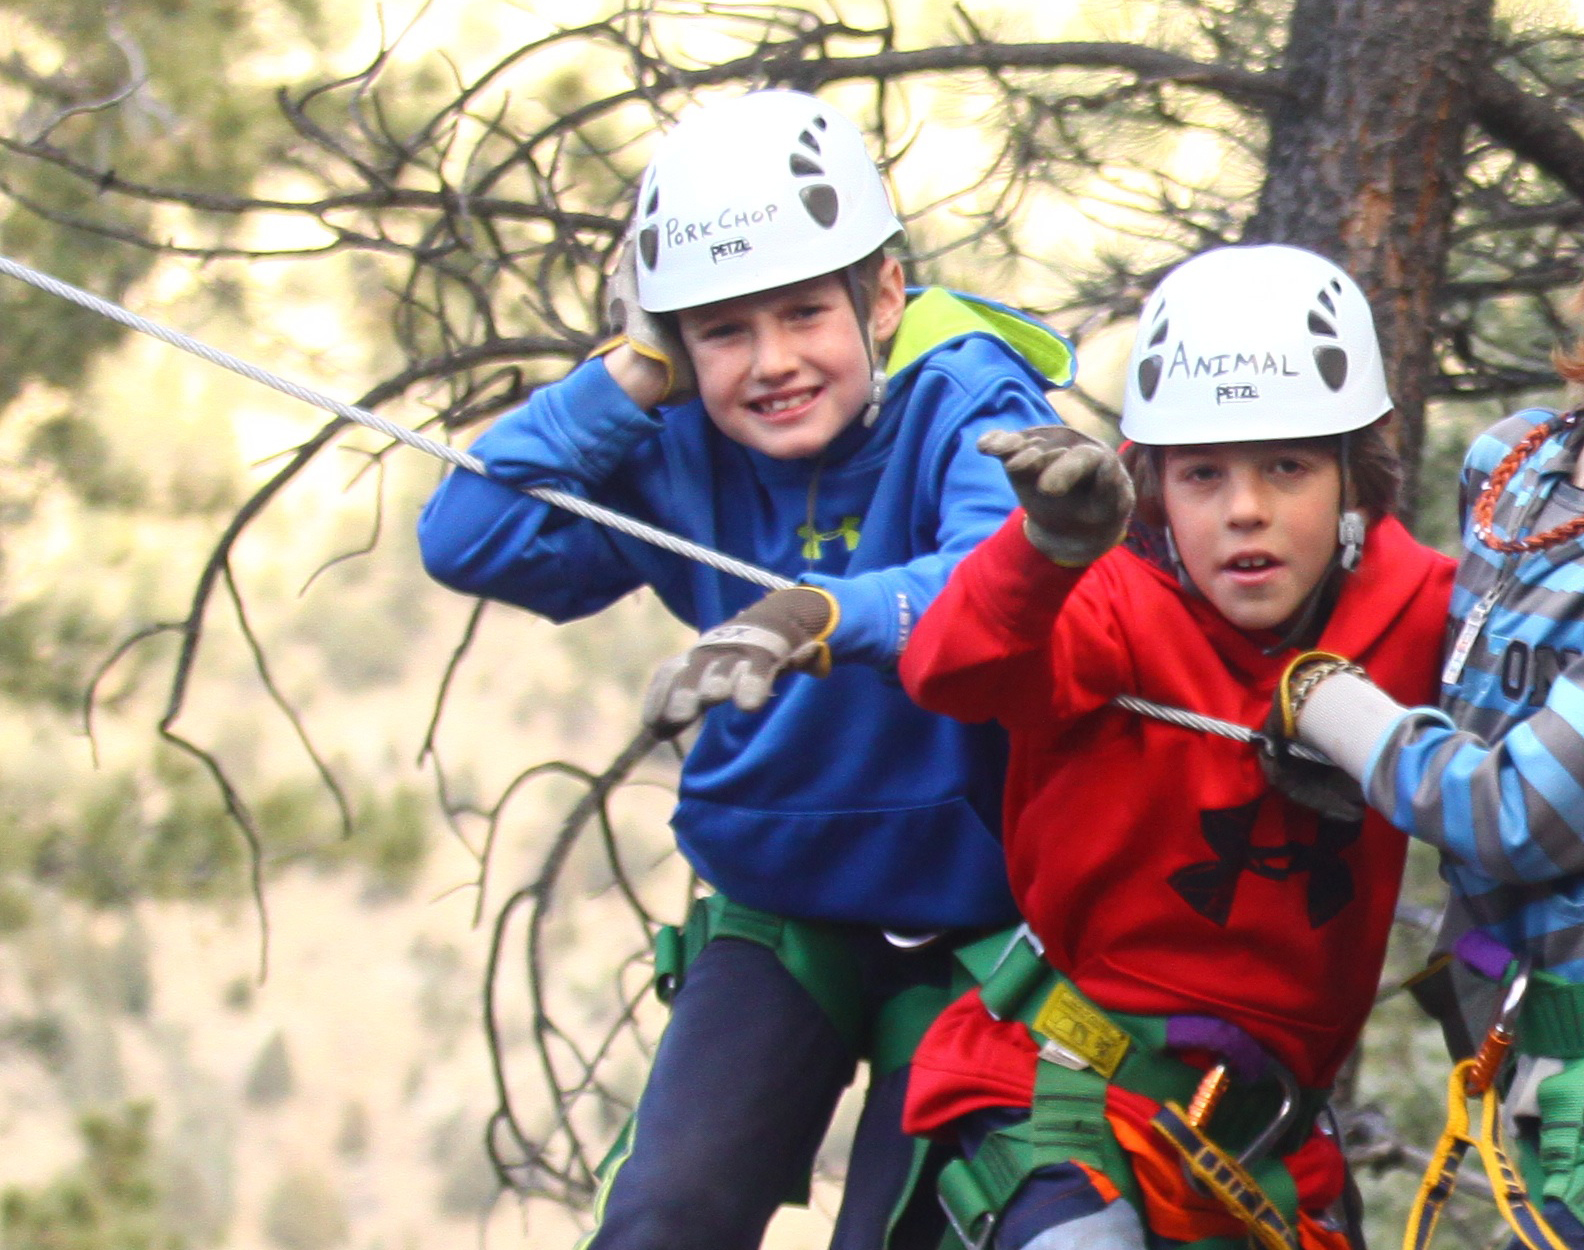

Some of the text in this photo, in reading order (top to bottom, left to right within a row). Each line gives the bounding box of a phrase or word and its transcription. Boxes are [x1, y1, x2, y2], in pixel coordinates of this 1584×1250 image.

[665, 204, 778, 248] PORK CHOP
[710, 238, 752, 264] PETZL
[1168, 340, 1300, 379] ANIMAL
[1216, 385, 1259, 406] PETZL
